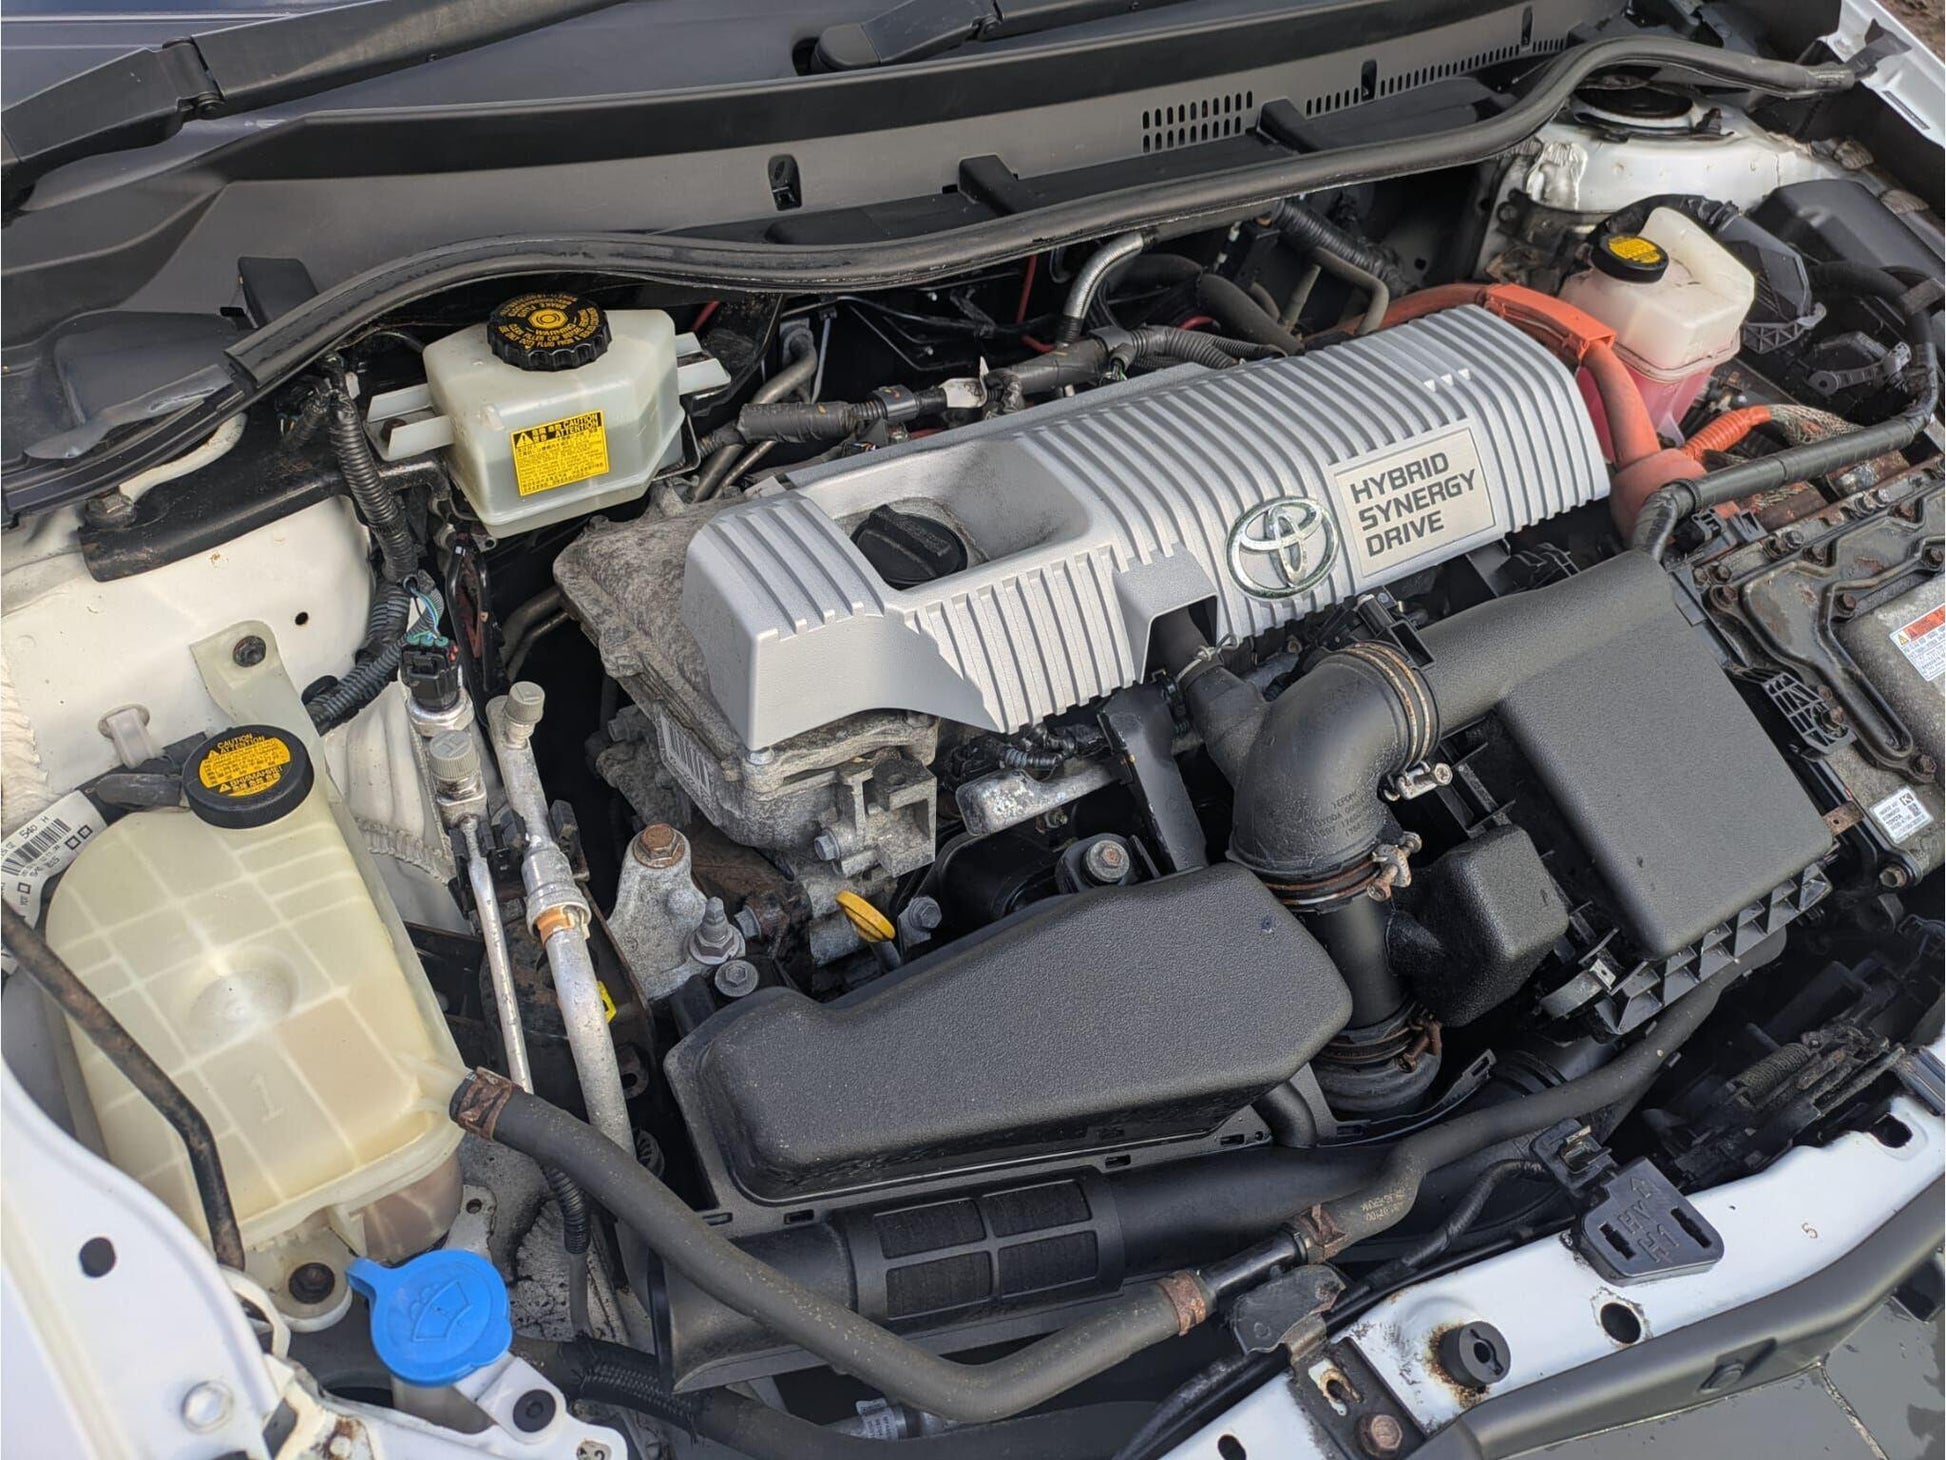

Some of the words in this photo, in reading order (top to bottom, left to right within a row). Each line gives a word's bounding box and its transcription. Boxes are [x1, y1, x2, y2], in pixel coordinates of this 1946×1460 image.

[555, 420, 599, 438] ATTENTION
[563, 413, 598, 429] CAUTION
[1350, 452, 1449, 504] HYBRID
[1358, 468, 1475, 532] SYNERGY
[1365, 510, 1444, 557] DRIVE
[217, 733, 253, 749] CAUTION
[220, 736, 265, 755] ATTENTION
